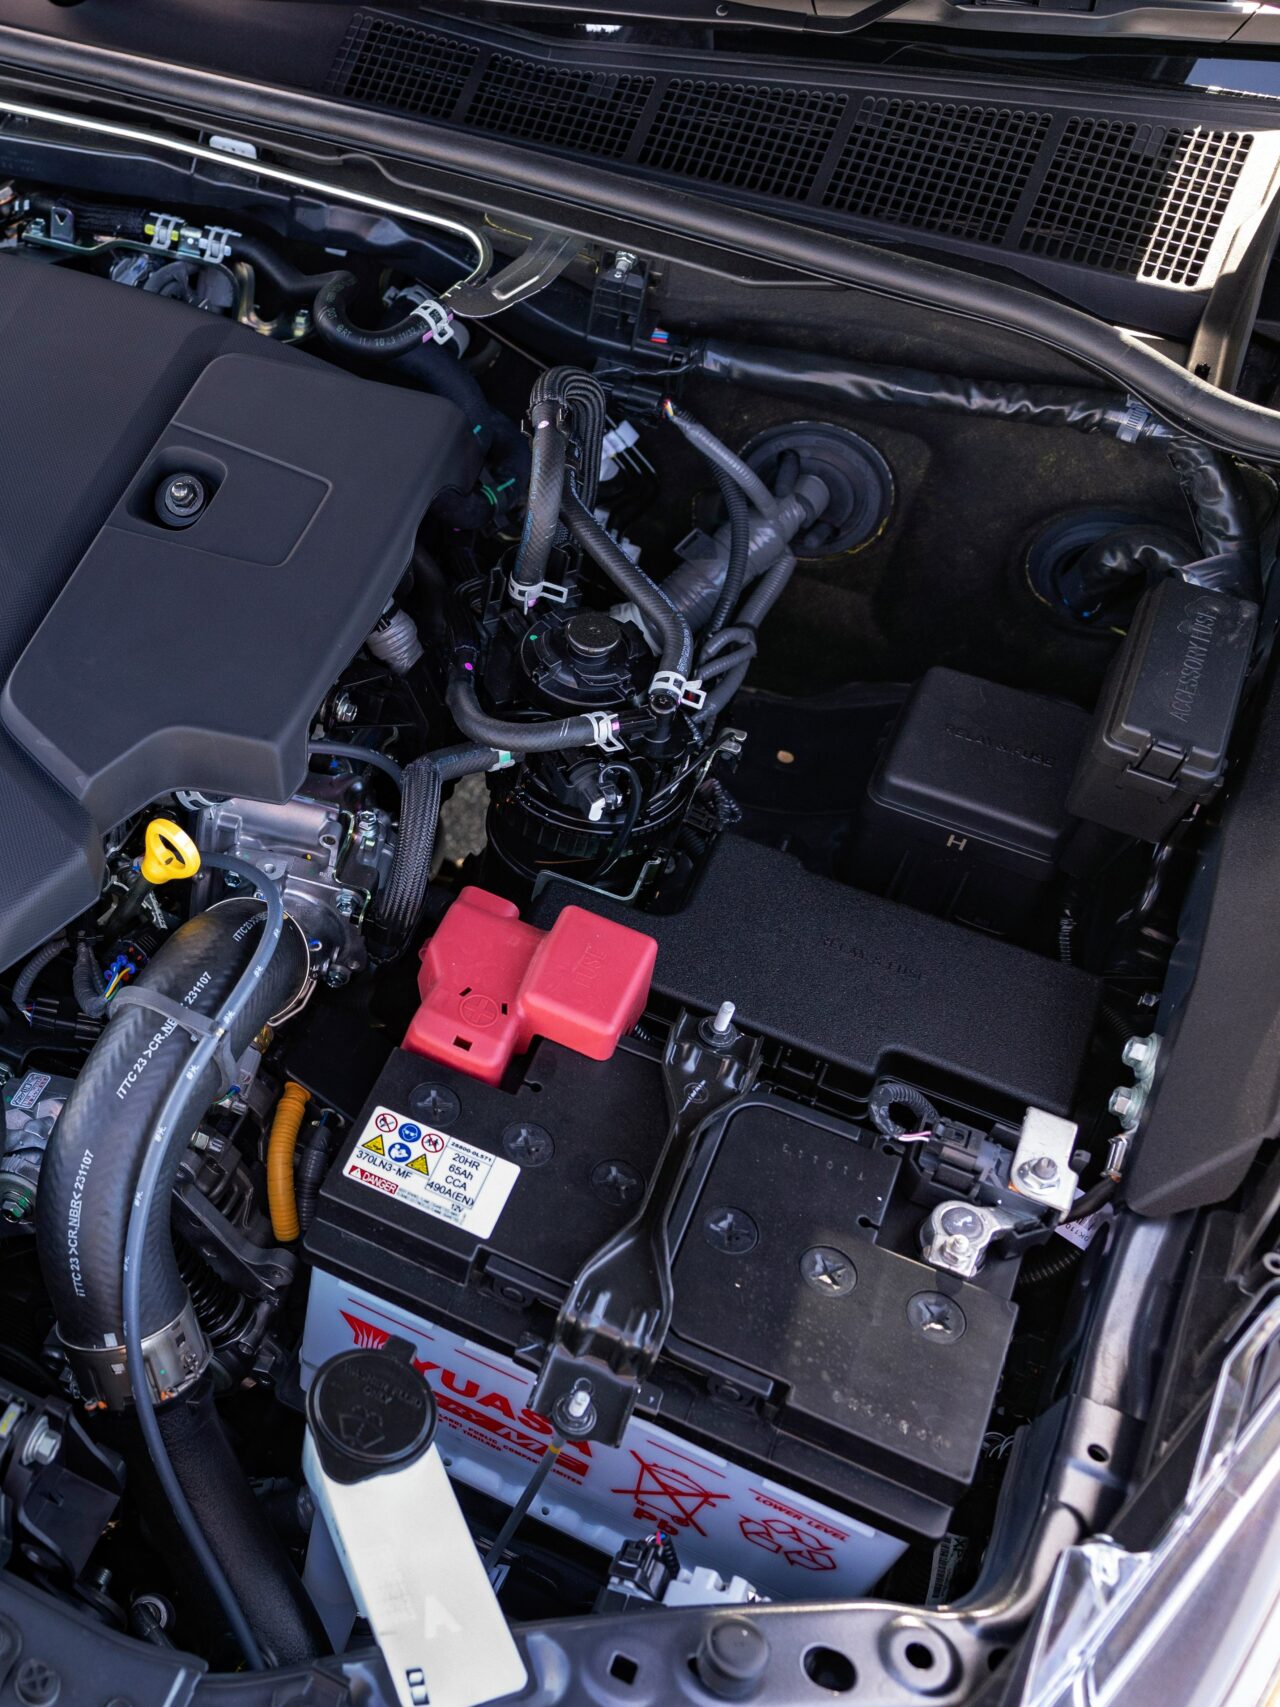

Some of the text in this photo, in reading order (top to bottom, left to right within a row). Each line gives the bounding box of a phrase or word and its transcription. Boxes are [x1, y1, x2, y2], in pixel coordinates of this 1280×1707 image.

[1167, 638, 1208, 724] ACCESSORY
[946, 834, 968, 852] H
[134, 1058, 149, 1076] 23
[184, 971, 212, 1005] 231107
[356, 1150, 413, 1180] 370LN3-MF
[448, 1166, 474, 1181] 65Ah
[452, 1153, 481, 1171] 20HR
[361, 1172, 398, 1194] DANGER
[427, 1181, 475, 1207] 490A(EN)
[445, 1175, 467, 1191] CCA
[71, 1256, 80, 1272] 23
[76, 1148, 95, 1192] 231107
[451, 1203, 464, 1214] 12V
[463, 1429, 503, 1452] THAILAND
[503, 1444, 541, 1465] COMPAN
[631, 1505, 681, 1537] Pb
[755, 1496, 850, 1543] LOWER LEVEL
